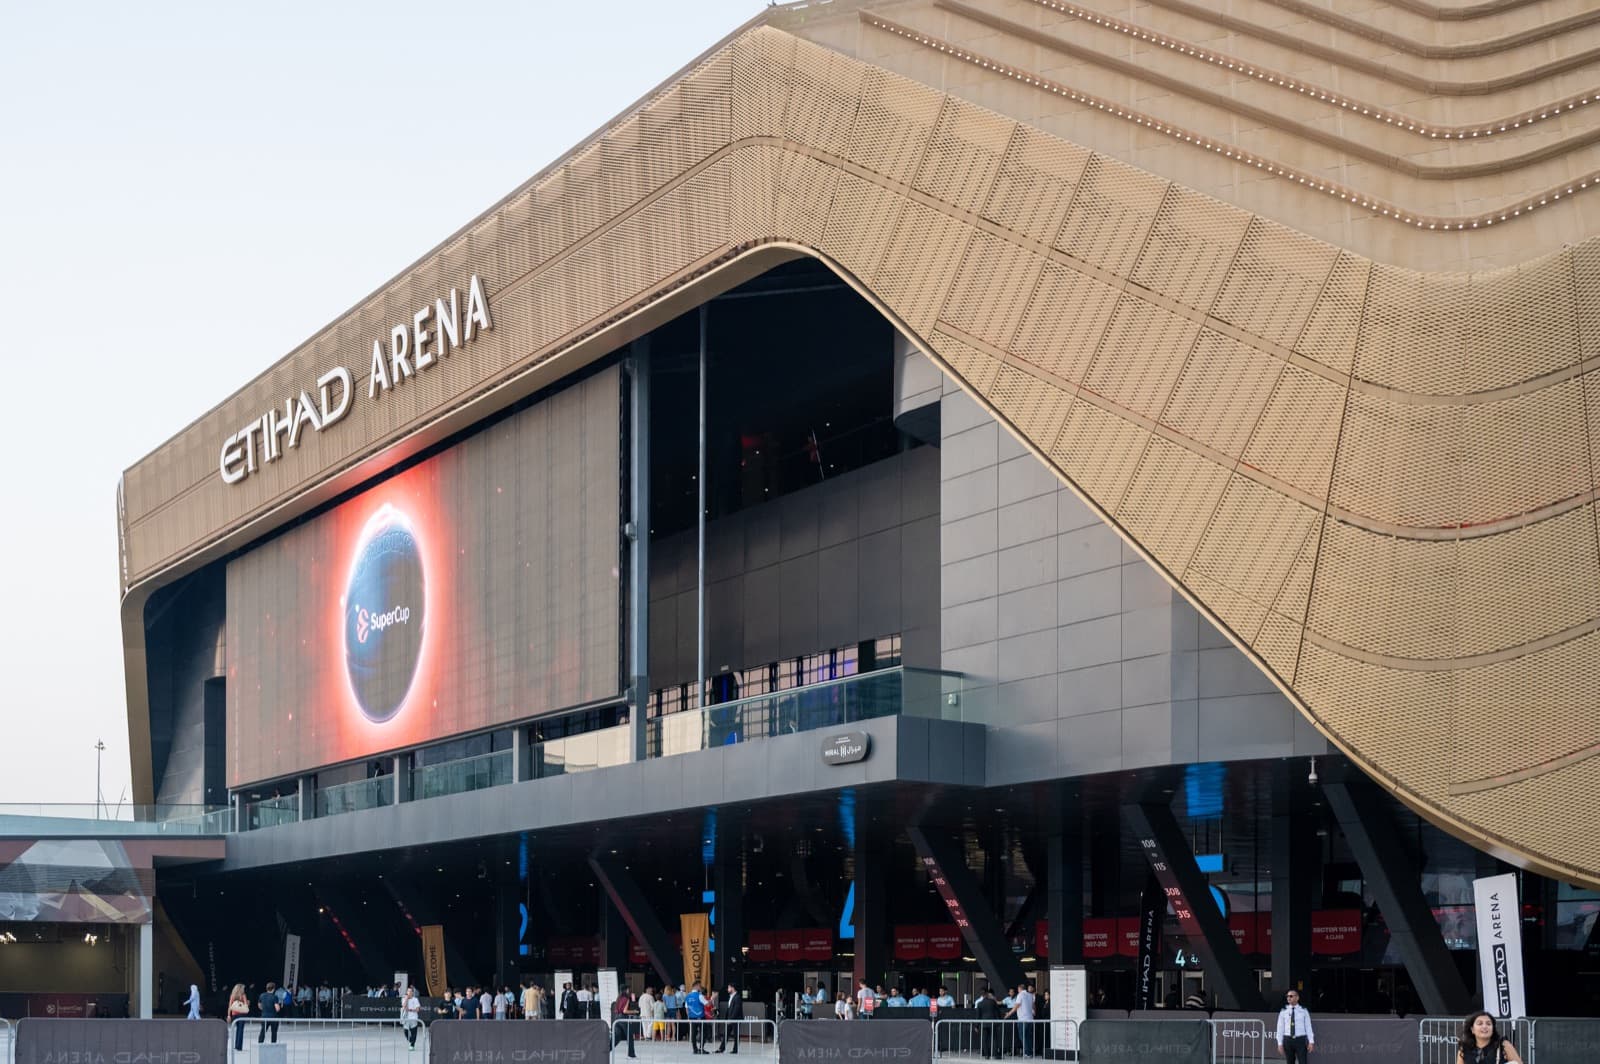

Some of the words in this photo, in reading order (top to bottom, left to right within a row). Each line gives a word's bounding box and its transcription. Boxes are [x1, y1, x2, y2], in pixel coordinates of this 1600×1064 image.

[220, 365, 354, 484] ETIHAD
[368, 274, 492, 399] ARENA
[370, 605, 410, 632] SuperCup
[1142, 839, 1156, 848] 108
[1154, 862, 1167, 871] 115
[1177, 910, 1191, 919] 315
[1490, 892, 1503, 939] ARENA
[1145, 909, 1155, 951] ARENA
[429, 943, 439, 987] WELCOME
[1175, 949, 1186, 967] 4
[1496, 946, 1510, 1017] ETIHAD
[1222, 1029, 1260, 1039] ETIHAD
